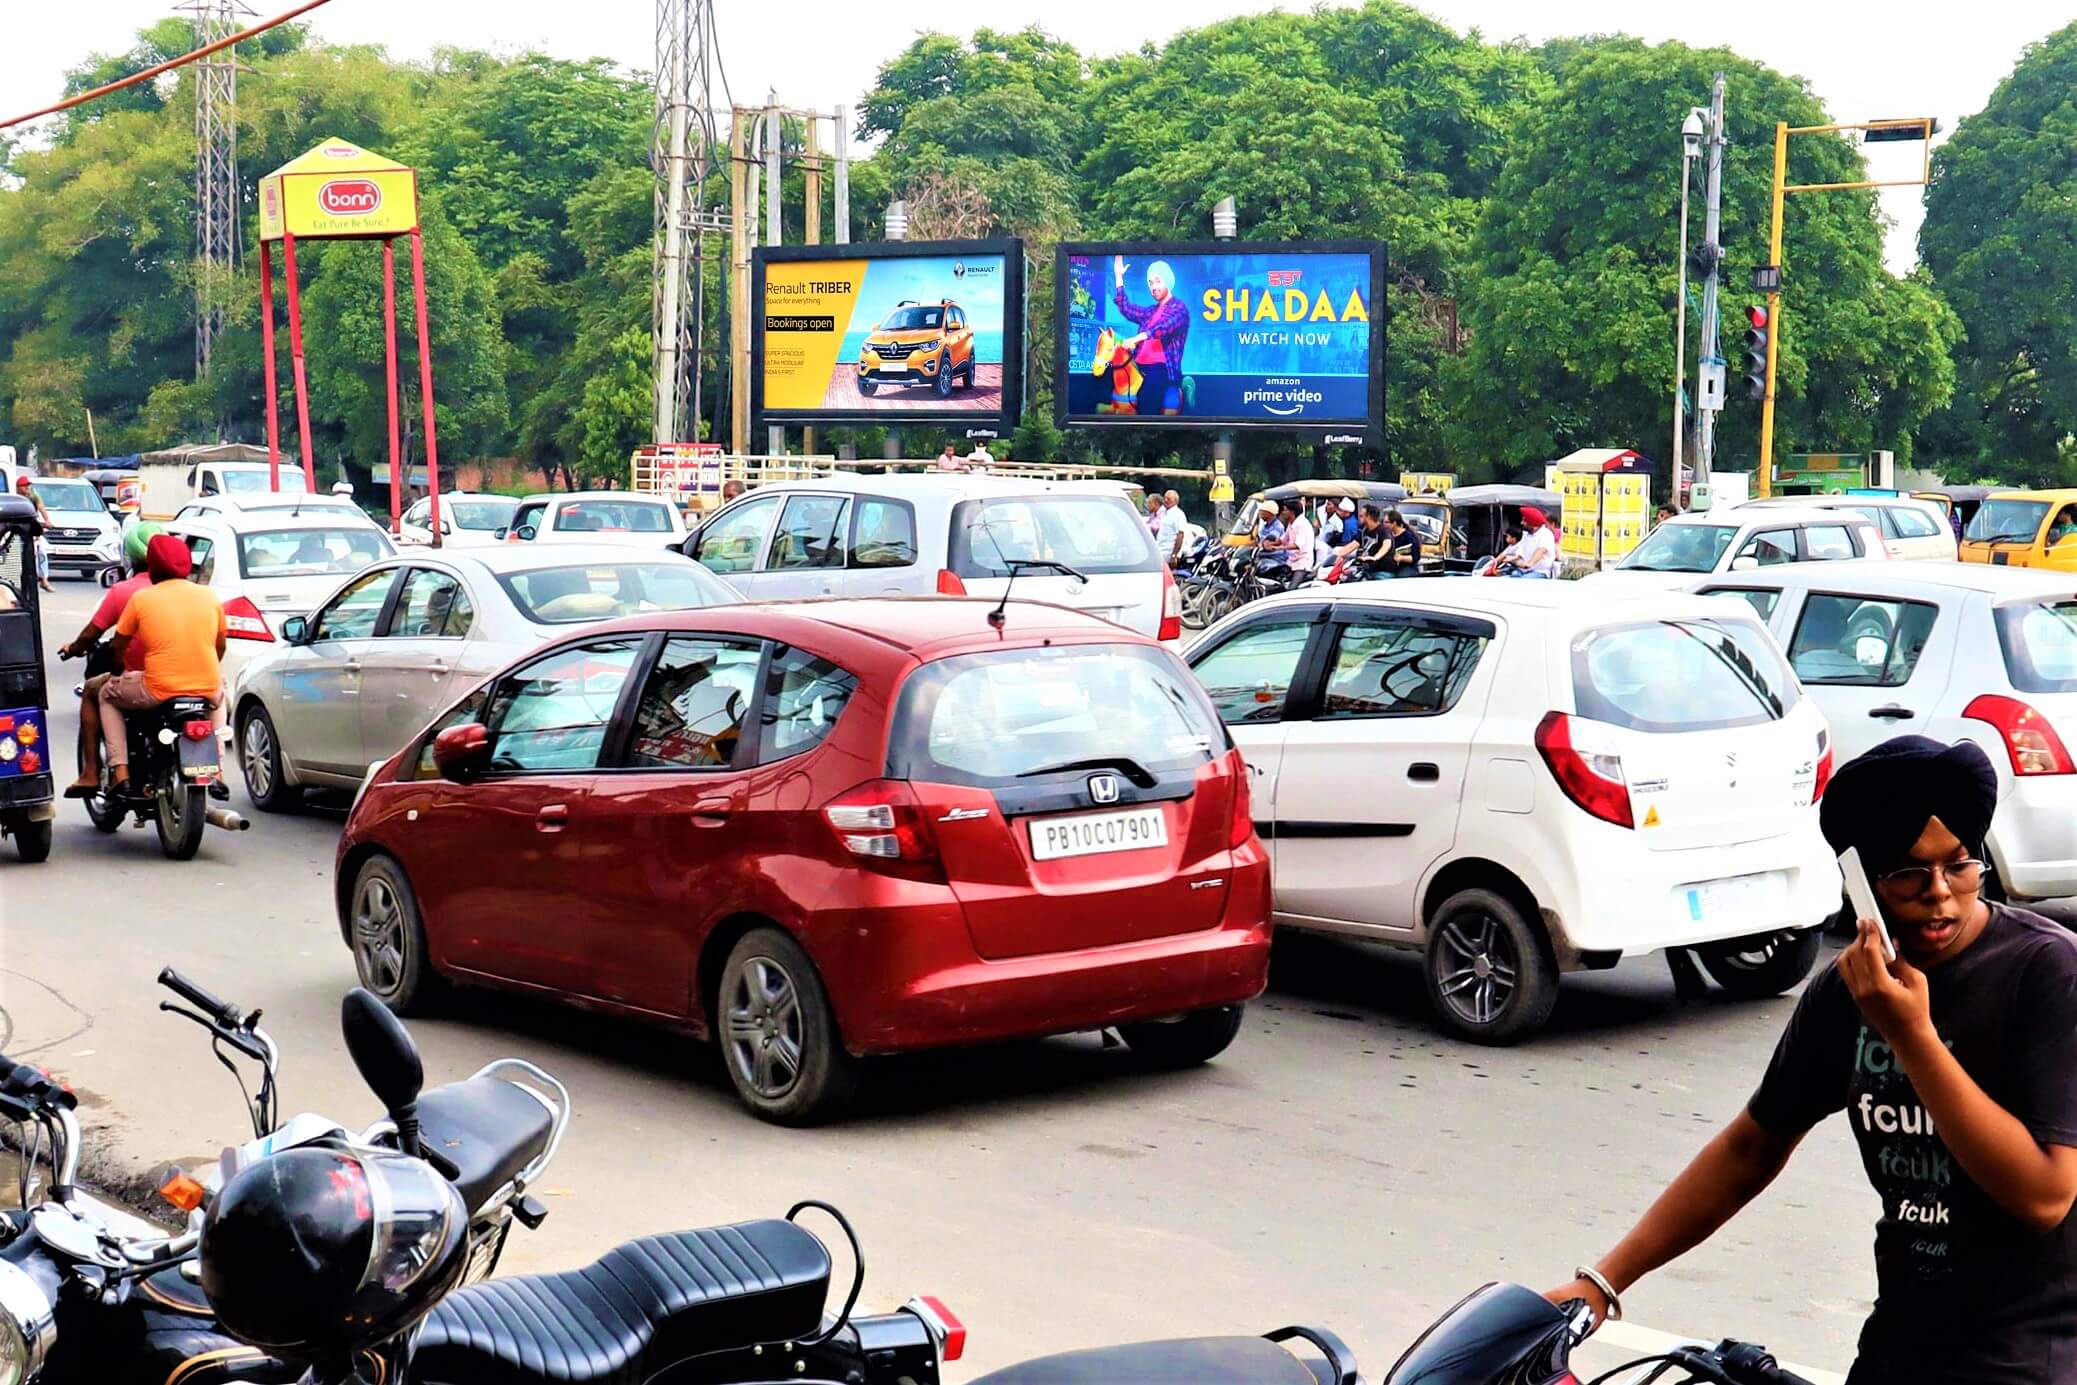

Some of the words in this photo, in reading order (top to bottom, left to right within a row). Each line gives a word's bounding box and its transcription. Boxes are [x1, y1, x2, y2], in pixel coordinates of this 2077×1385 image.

[326, 187, 375, 207] bonn
[328, 219, 349, 230] Pure
[351, 218, 361, 228] Be
[766, 282, 806, 295] Renault
[809, 282, 852, 294] TRIBER
[791, 297, 821, 306] everything
[1202, 288, 1370, 322] SHADAA
[767, 317, 808, 331] Bookings
[809, 319, 833, 331] open
[1238, 332, 1289, 346] WATCH
[1294, 332, 1331, 346] NOW
[1243, 388, 1283, 404] prime
[1285, 388, 1322, 402] video
[1046, 815, 1161, 852] PB10CQ7901
[1898, 1199, 1950, 1225] fcuk
